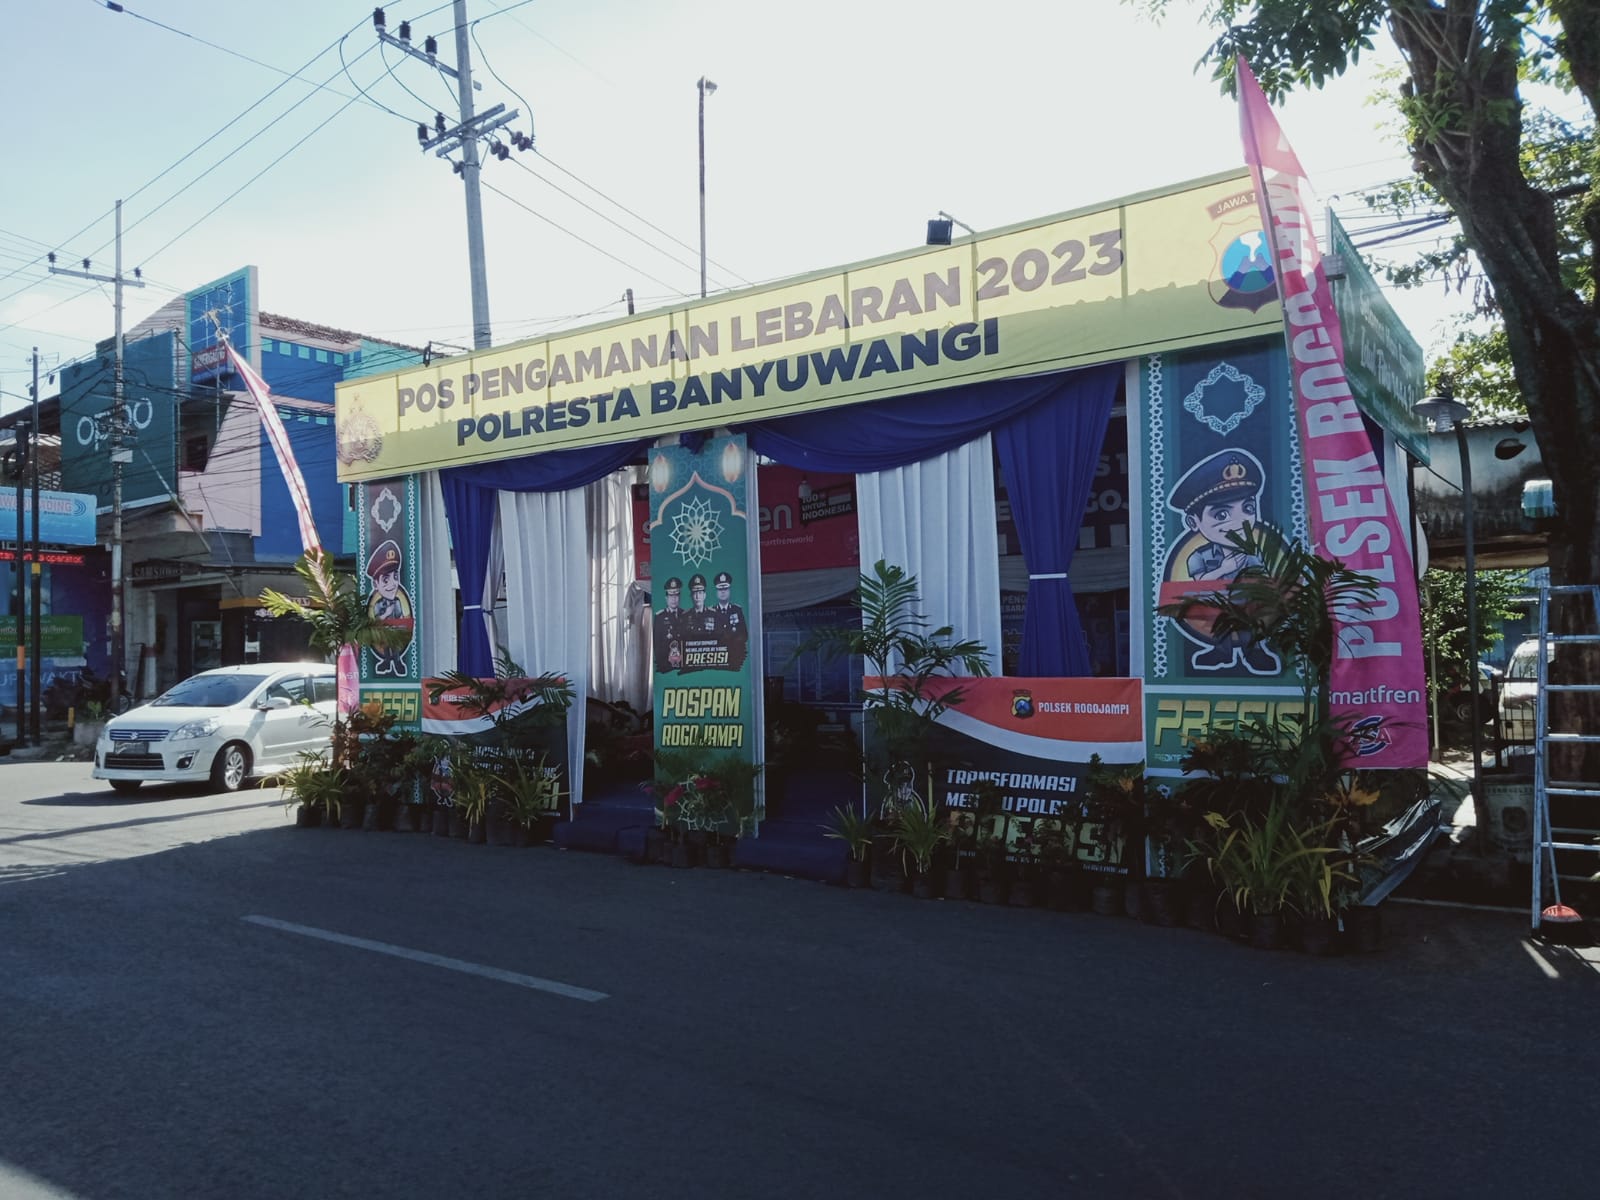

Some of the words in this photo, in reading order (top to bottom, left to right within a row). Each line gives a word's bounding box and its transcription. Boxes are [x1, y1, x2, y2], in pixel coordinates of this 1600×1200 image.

[1216, 194, 1248, 214] JAWA
[397, 370, 456, 417] POS
[461, 319, 720, 404] PENGAMANAN
[731, 265, 962, 352] LEBARAN
[975, 229, 1126, 302] 2023
[456, 386, 642, 446] POLRESTA
[650, 317, 1000, 416] BANYUWANGI
[802, 503, 852, 520] INDONESIA
[1314, 450, 1403, 660] POLSEK
[685, 651, 729, 665] PRESISI
[662, 687, 740, 718] POSPAM
[1329, 685, 1421, 706] martfren
[1038, 701, 1072, 714] POLSEK
[1074, 702, 1130, 716] ROGOJAMPI
[661, 723, 744, 748] ROGOJAMPI
[946, 768, 1078, 793] TRANSFORMASI
